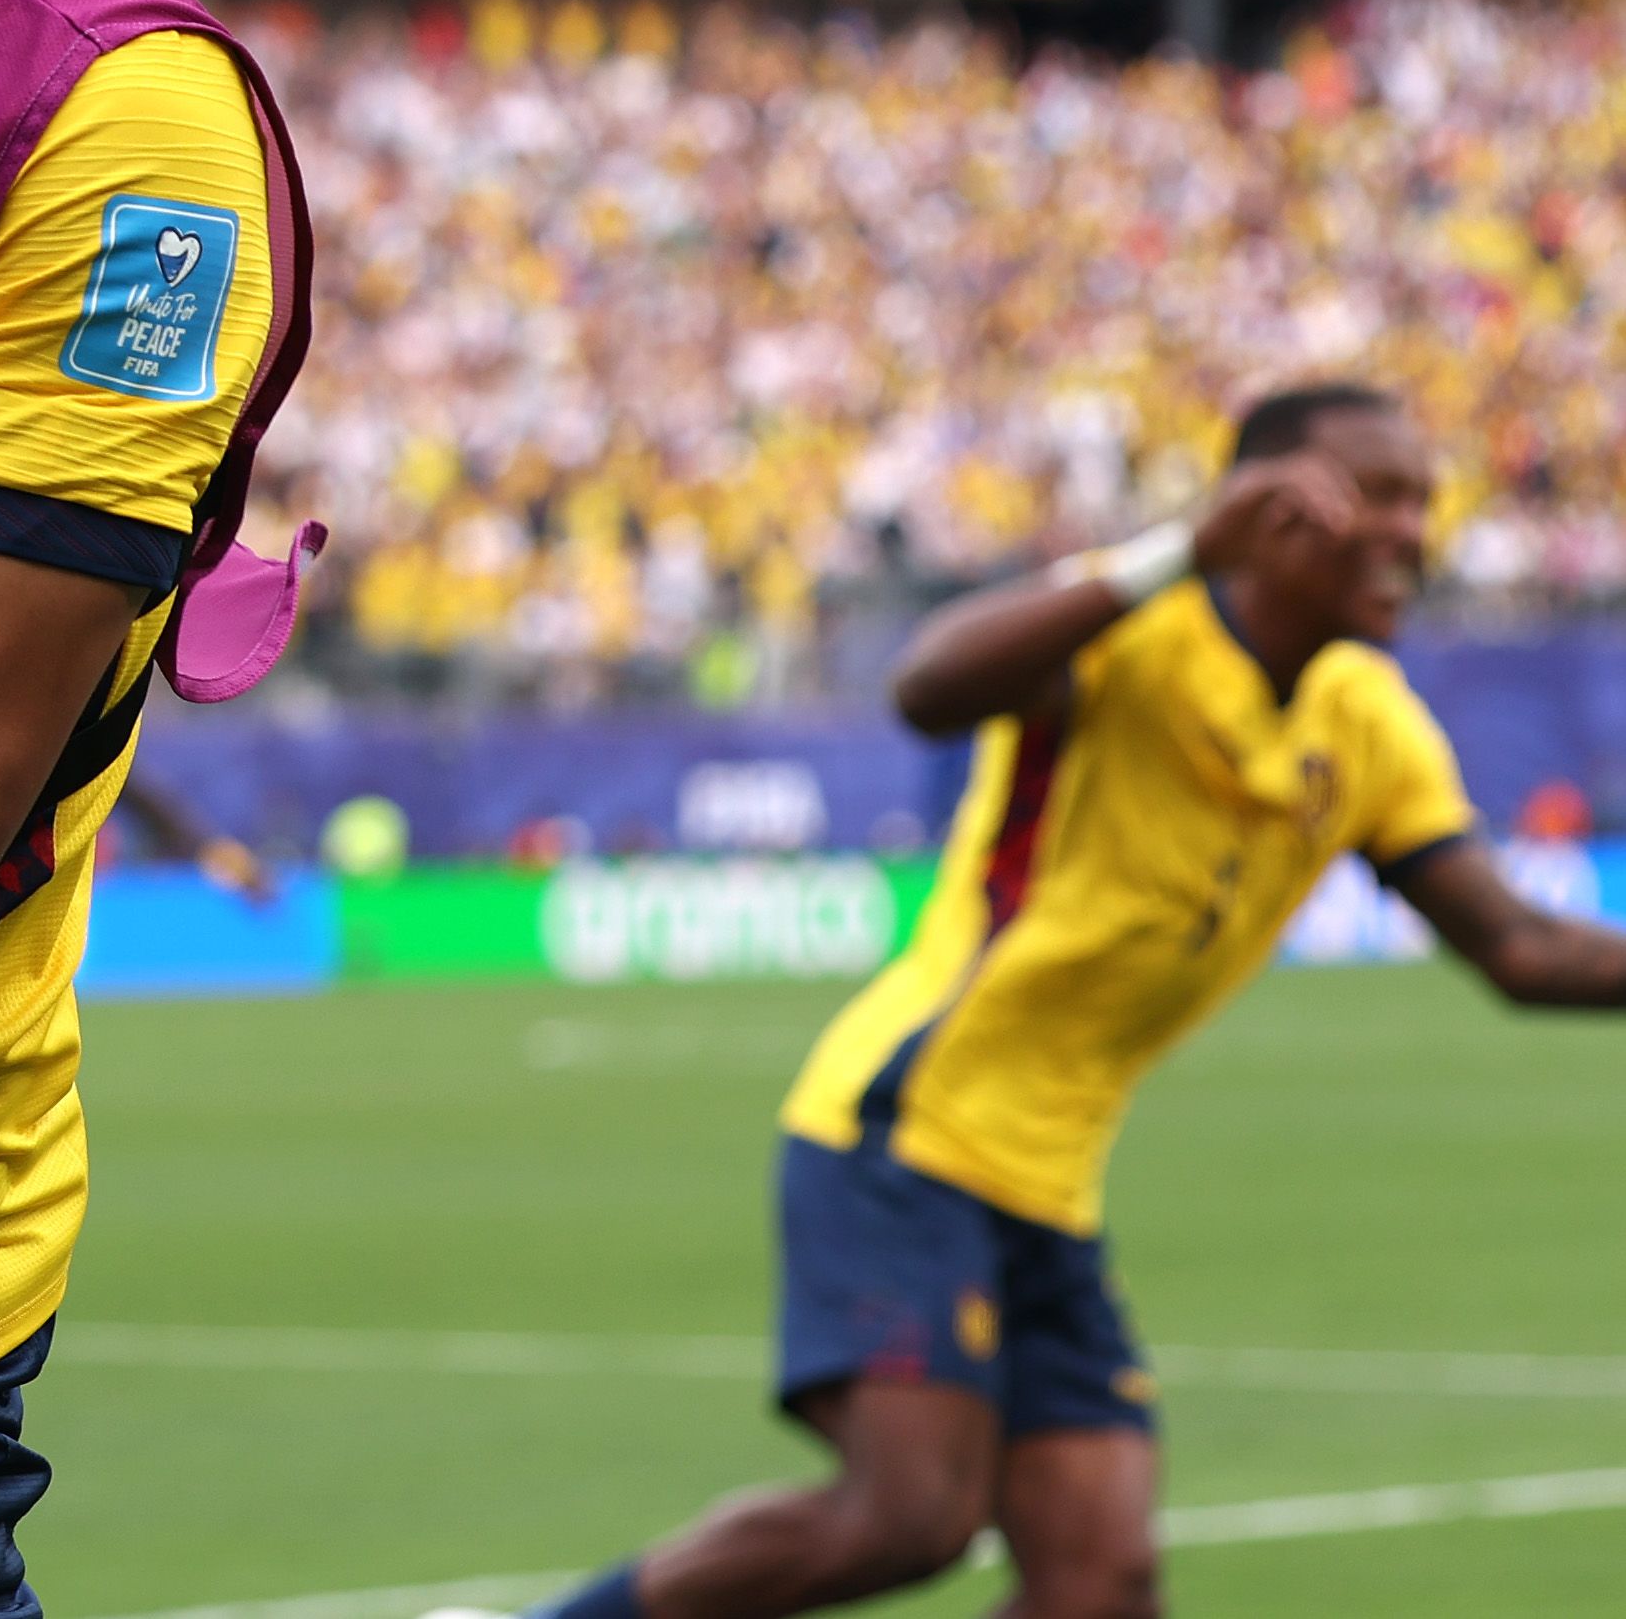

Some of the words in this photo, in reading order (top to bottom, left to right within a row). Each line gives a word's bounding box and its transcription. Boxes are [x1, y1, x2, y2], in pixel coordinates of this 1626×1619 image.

[126, 283, 173, 322] Unite
[172, 292, 198, 324] For
[116, 318, 187, 358] PEACE
[122, 356, 160, 378] FIFA
[539, 856, 897, 982] aramco
